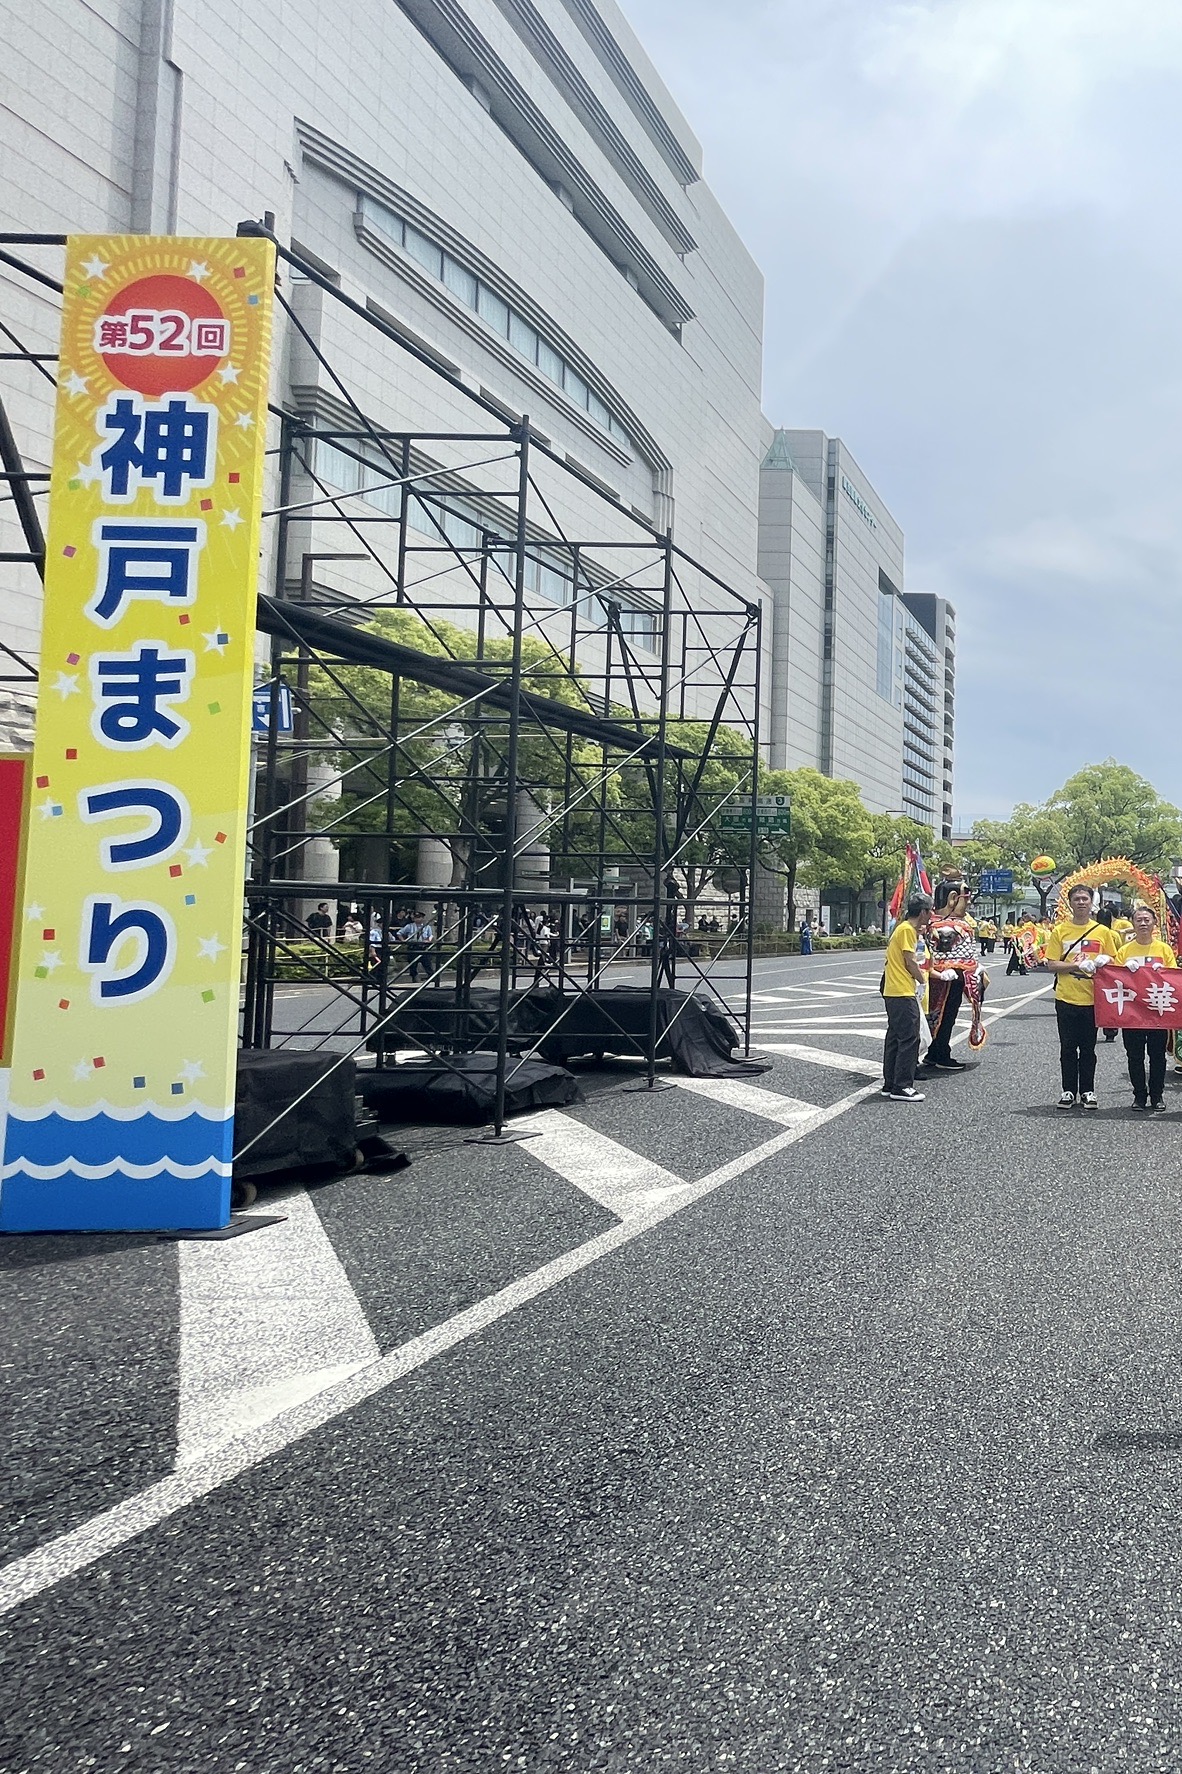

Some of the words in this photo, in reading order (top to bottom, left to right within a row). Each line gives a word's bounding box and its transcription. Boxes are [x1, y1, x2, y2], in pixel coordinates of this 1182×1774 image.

[99, 314, 225, 351] 第52回
[87, 399, 209, 999] 神戸まつり
